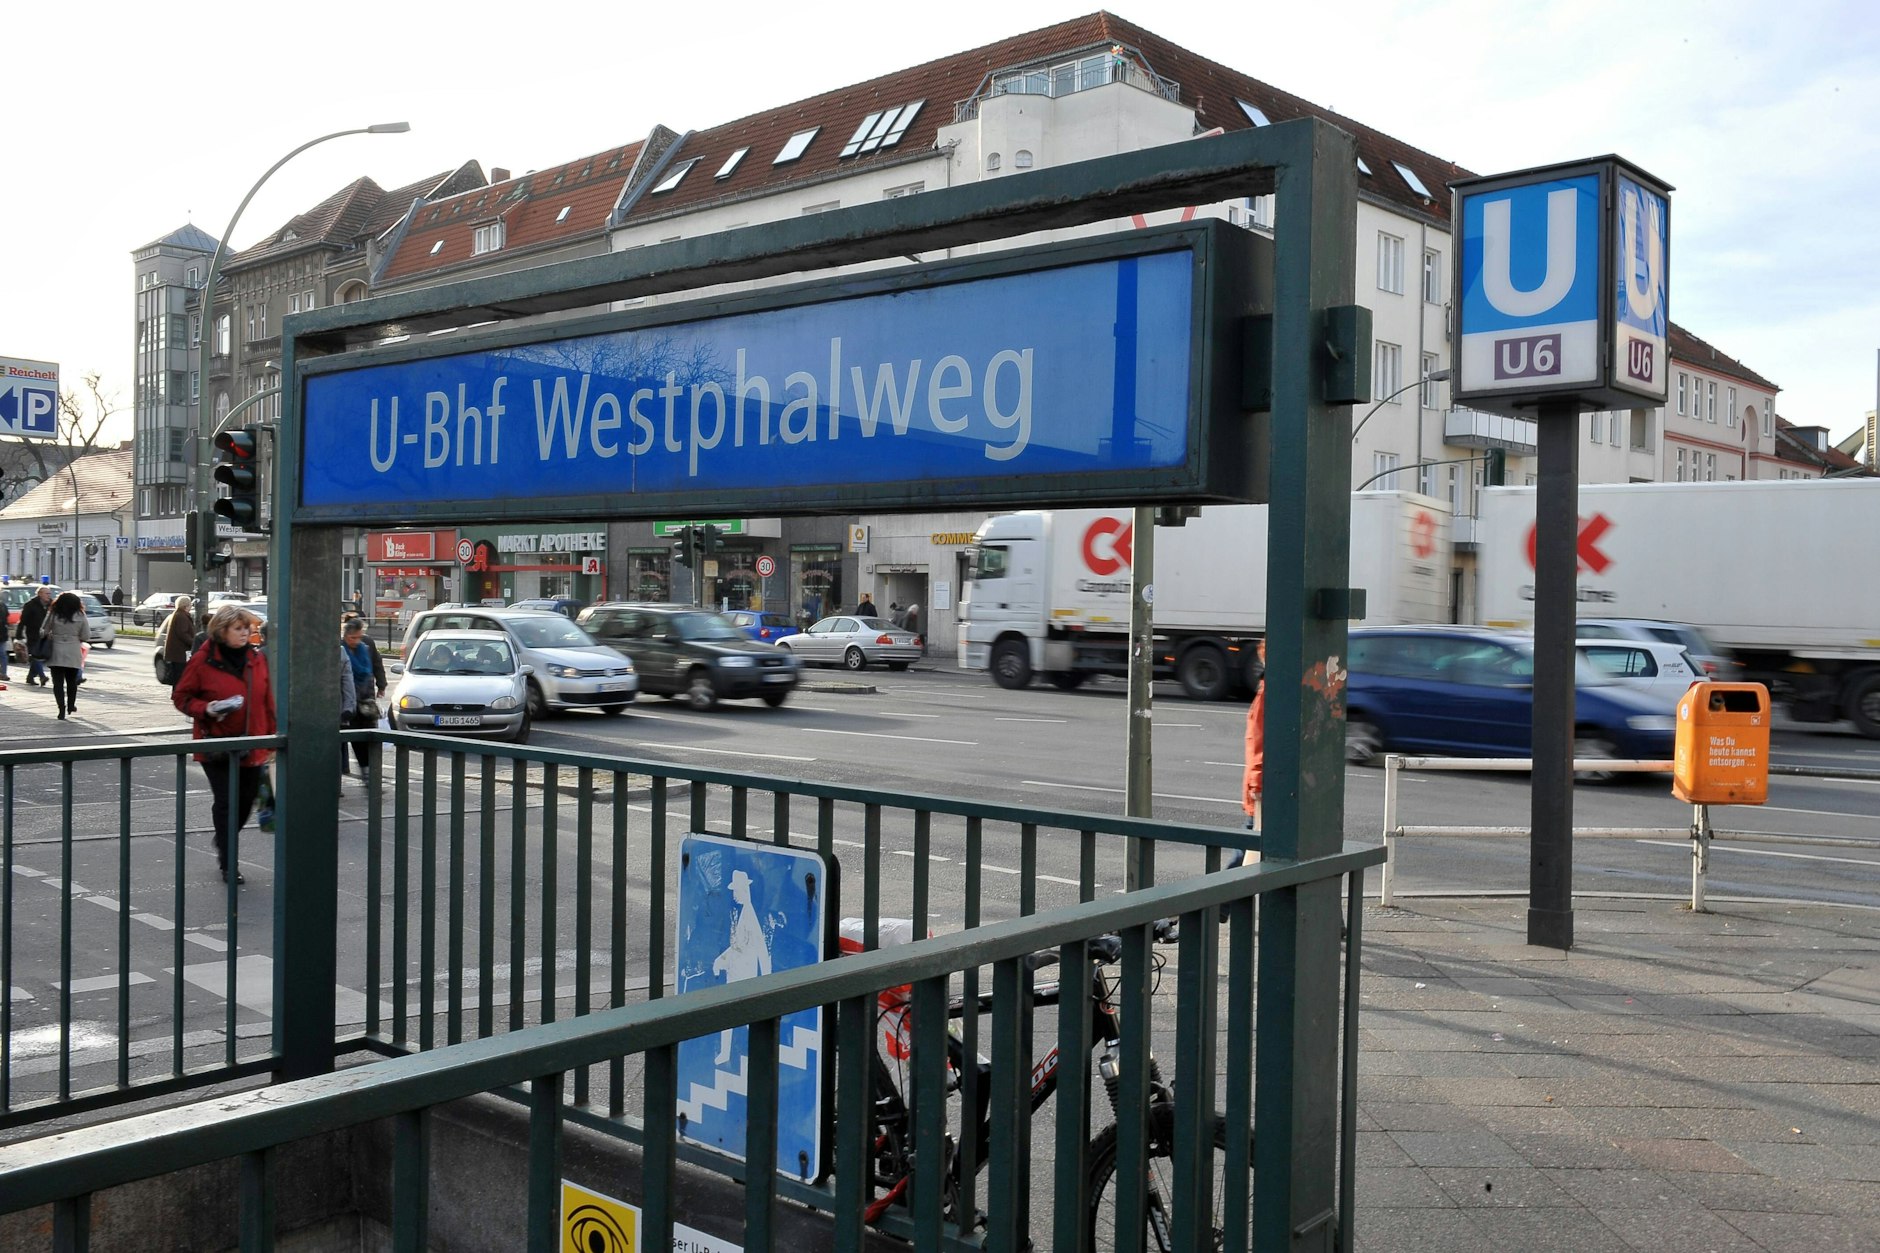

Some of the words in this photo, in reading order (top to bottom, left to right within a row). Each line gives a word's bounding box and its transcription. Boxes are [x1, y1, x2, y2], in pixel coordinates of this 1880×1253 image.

[1483, 188, 1577, 317] U
[1625, 190, 1659, 320] U
[1502, 339, 1555, 375] U6
[1631, 341, 1650, 377] U6
[9, 366, 56, 380] Reichelt
[28, 392, 51, 427] P
[370, 376, 507, 472] U-Bhf
[533, 337, 1033, 477] Westphalweg
[498, 535, 538, 552] MARKT
[539, 533, 606, 551] APOTHEKE
[930, 532, 976, 545] COMME
[461, 546, 470, 556] 30
[760, 562, 770, 571] 30
[1710, 736, 1725, 746] Was
[1726, 736, 1736, 746] Du
[1709, 747, 1730, 756] heute
[1731, 747, 1756, 757] kannst
[1709, 757, 1745, 768] entsorgen
